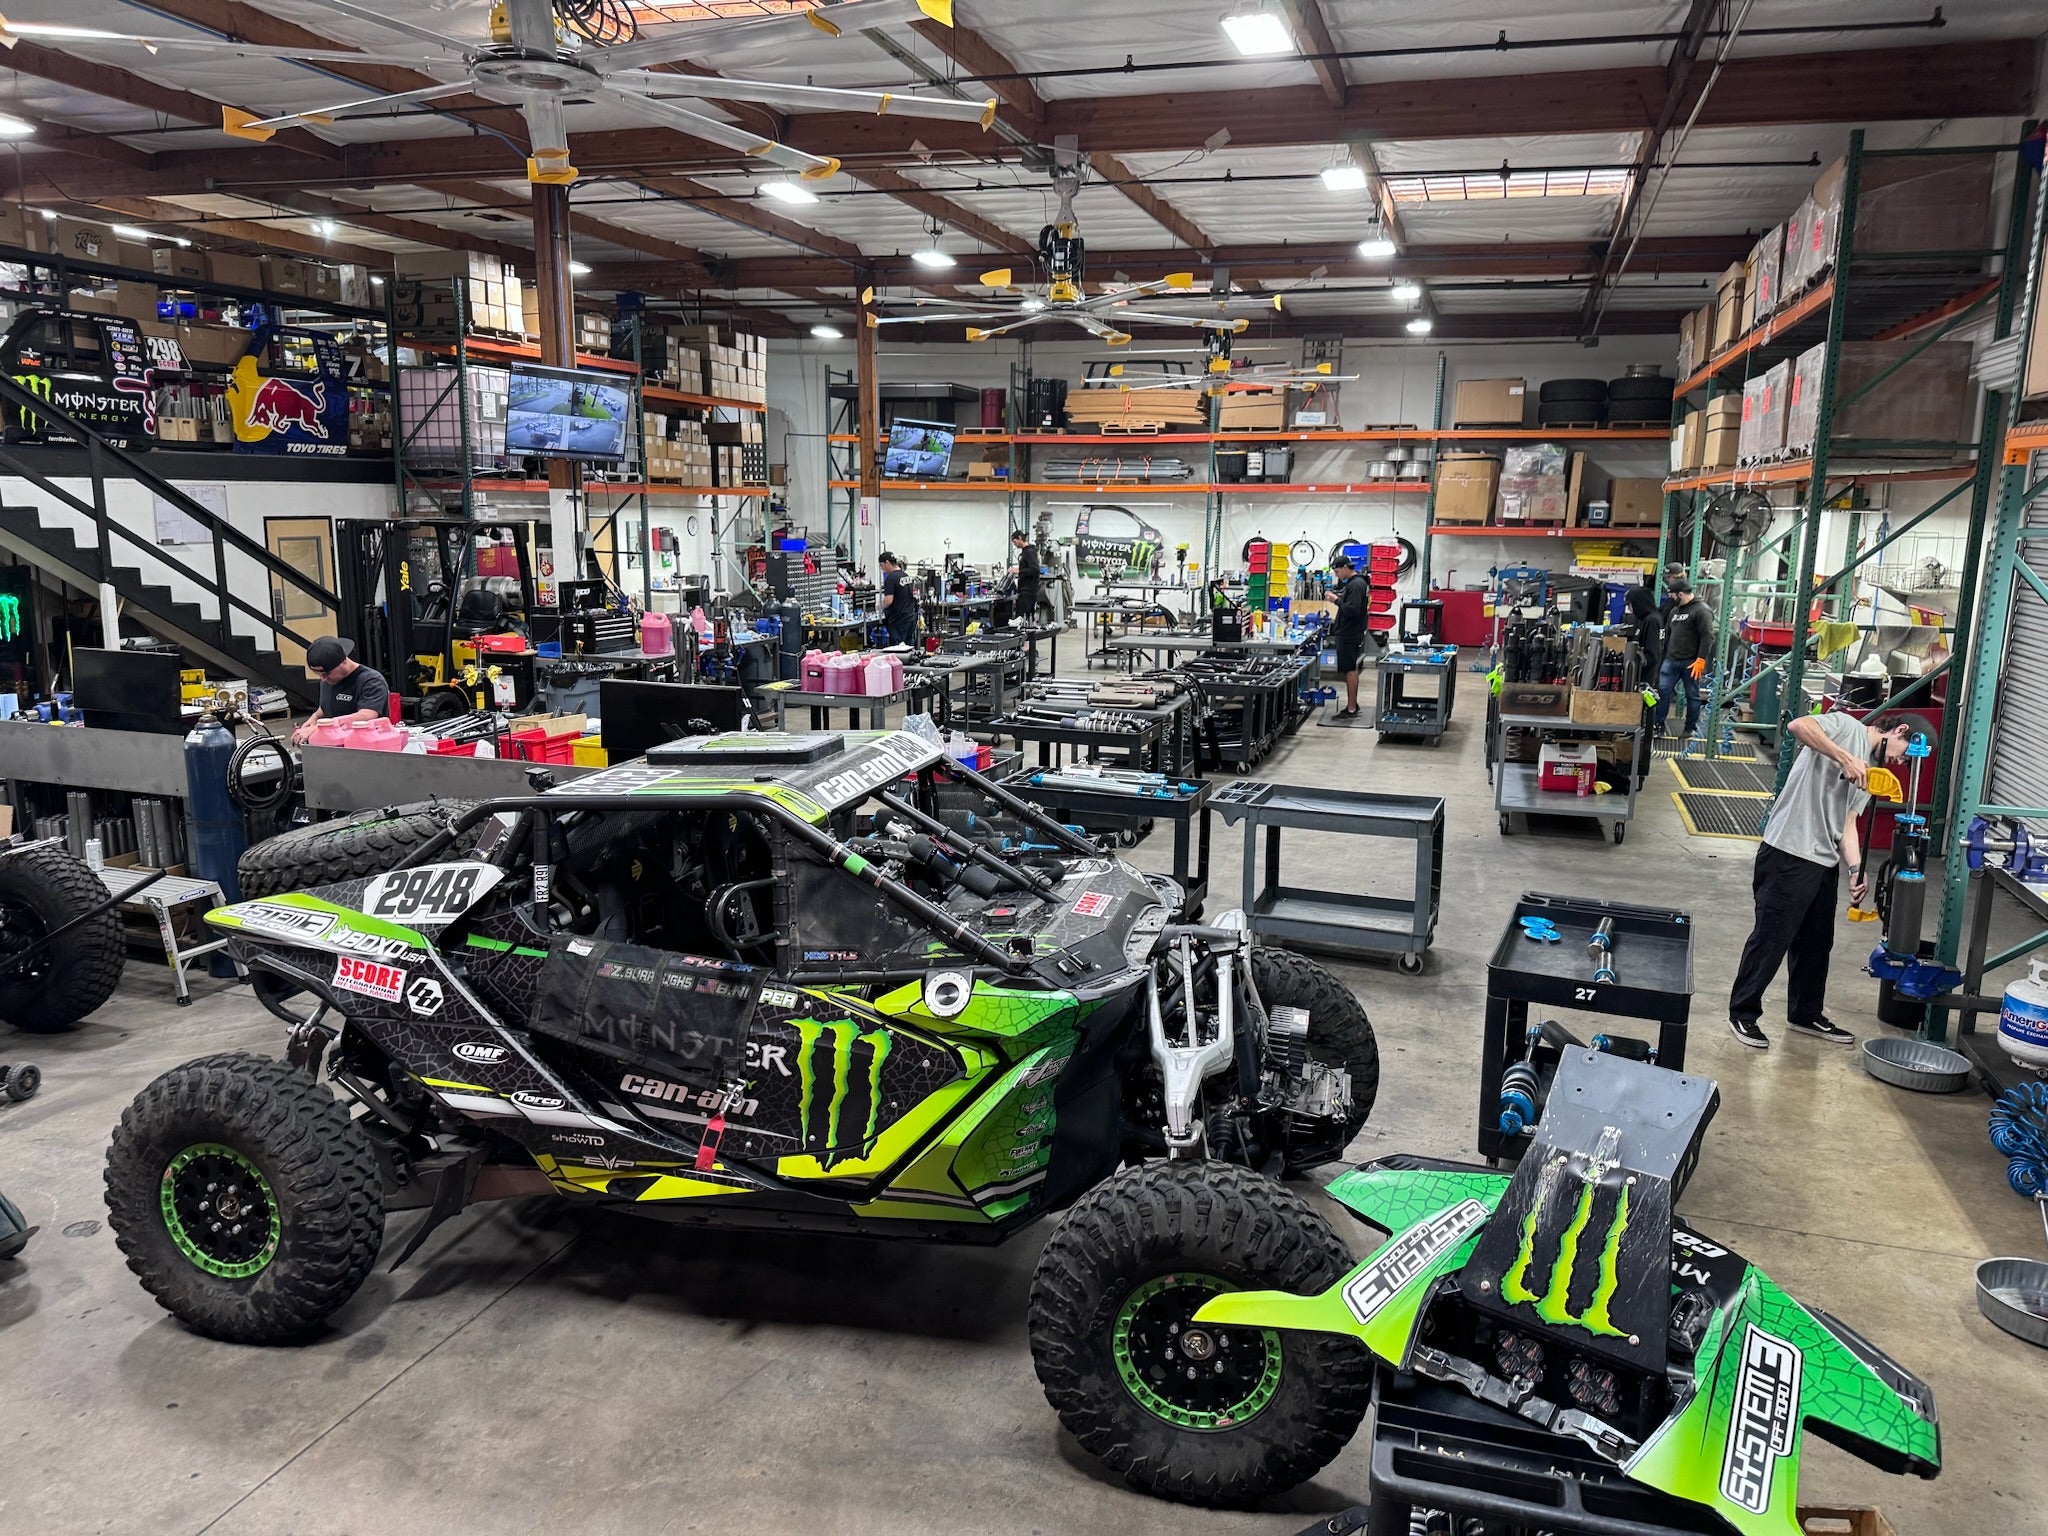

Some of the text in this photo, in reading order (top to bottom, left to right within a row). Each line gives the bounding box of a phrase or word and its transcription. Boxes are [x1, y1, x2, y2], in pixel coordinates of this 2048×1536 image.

[157, 360, 180, 370] SCORE
[54, 391, 141, 414] MONSTER
[68, 411, 129, 423] ENERGY
[286, 443, 347, 455] TOYO TIRES
[1082, 540, 1132, 553] MONSTER
[1094, 555, 1128, 566] TOYOTA
[399, 560, 410, 592] Yale
[814, 751, 905, 805] can-am
[374, 866, 480, 914] 2948
[401, 951, 427, 964] USA
[339, 957, 402, 991] SCORE
[337, 976, 399, 995] INTERNATIONAL
[369, 985, 398, 1001] RACING
[1574, 987, 1597, 1001] 27
[2003, 1008, 2048, 1031] AmeriG
[2006, 1024, 2025, 1034] PROPANE
[460, 1046, 504, 1058] OMF
[517, 1092, 562, 1105] Torco
[620, 1073, 759, 1117] can-am
[1770, 1418, 1786, 1450] OFF
